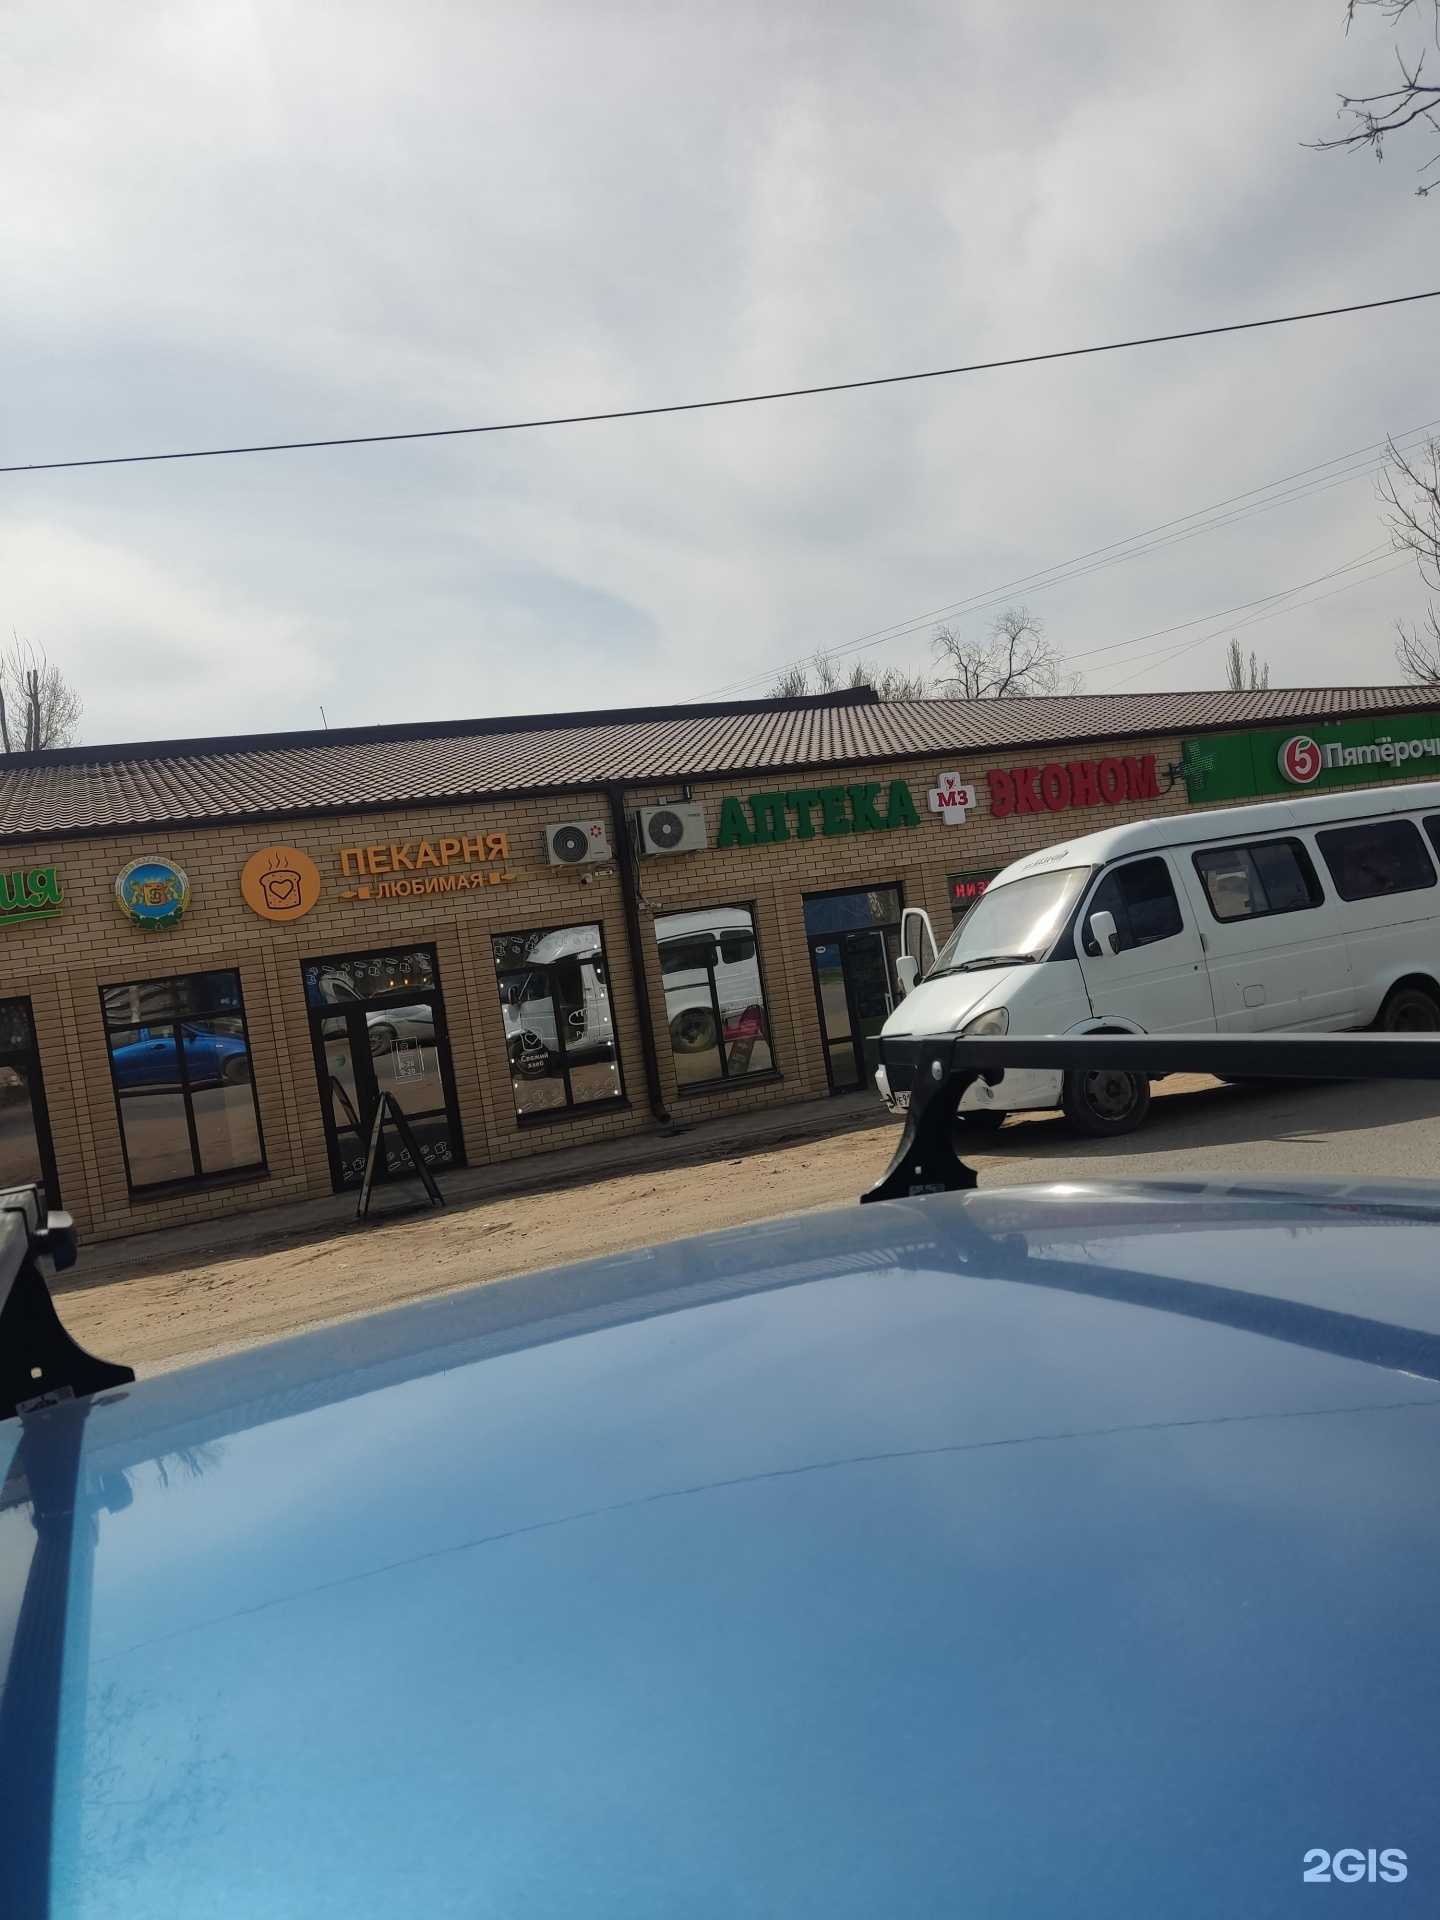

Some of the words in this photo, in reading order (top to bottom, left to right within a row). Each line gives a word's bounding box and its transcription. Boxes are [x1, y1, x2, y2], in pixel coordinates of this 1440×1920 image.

[1295, 739, 1313, 774] 5
[1323, 737, 1440, 768] Пятёроч
[717, 779, 921, 848] АПТЕКА
[987, 753, 1160, 817] ЭКОНОМ
[340, 832, 509, 876] ПЕКАРНЯ
[377, 872, 484, 899] ЛЮБИМАЯ
[955, 880, 991, 897] НИЗ
